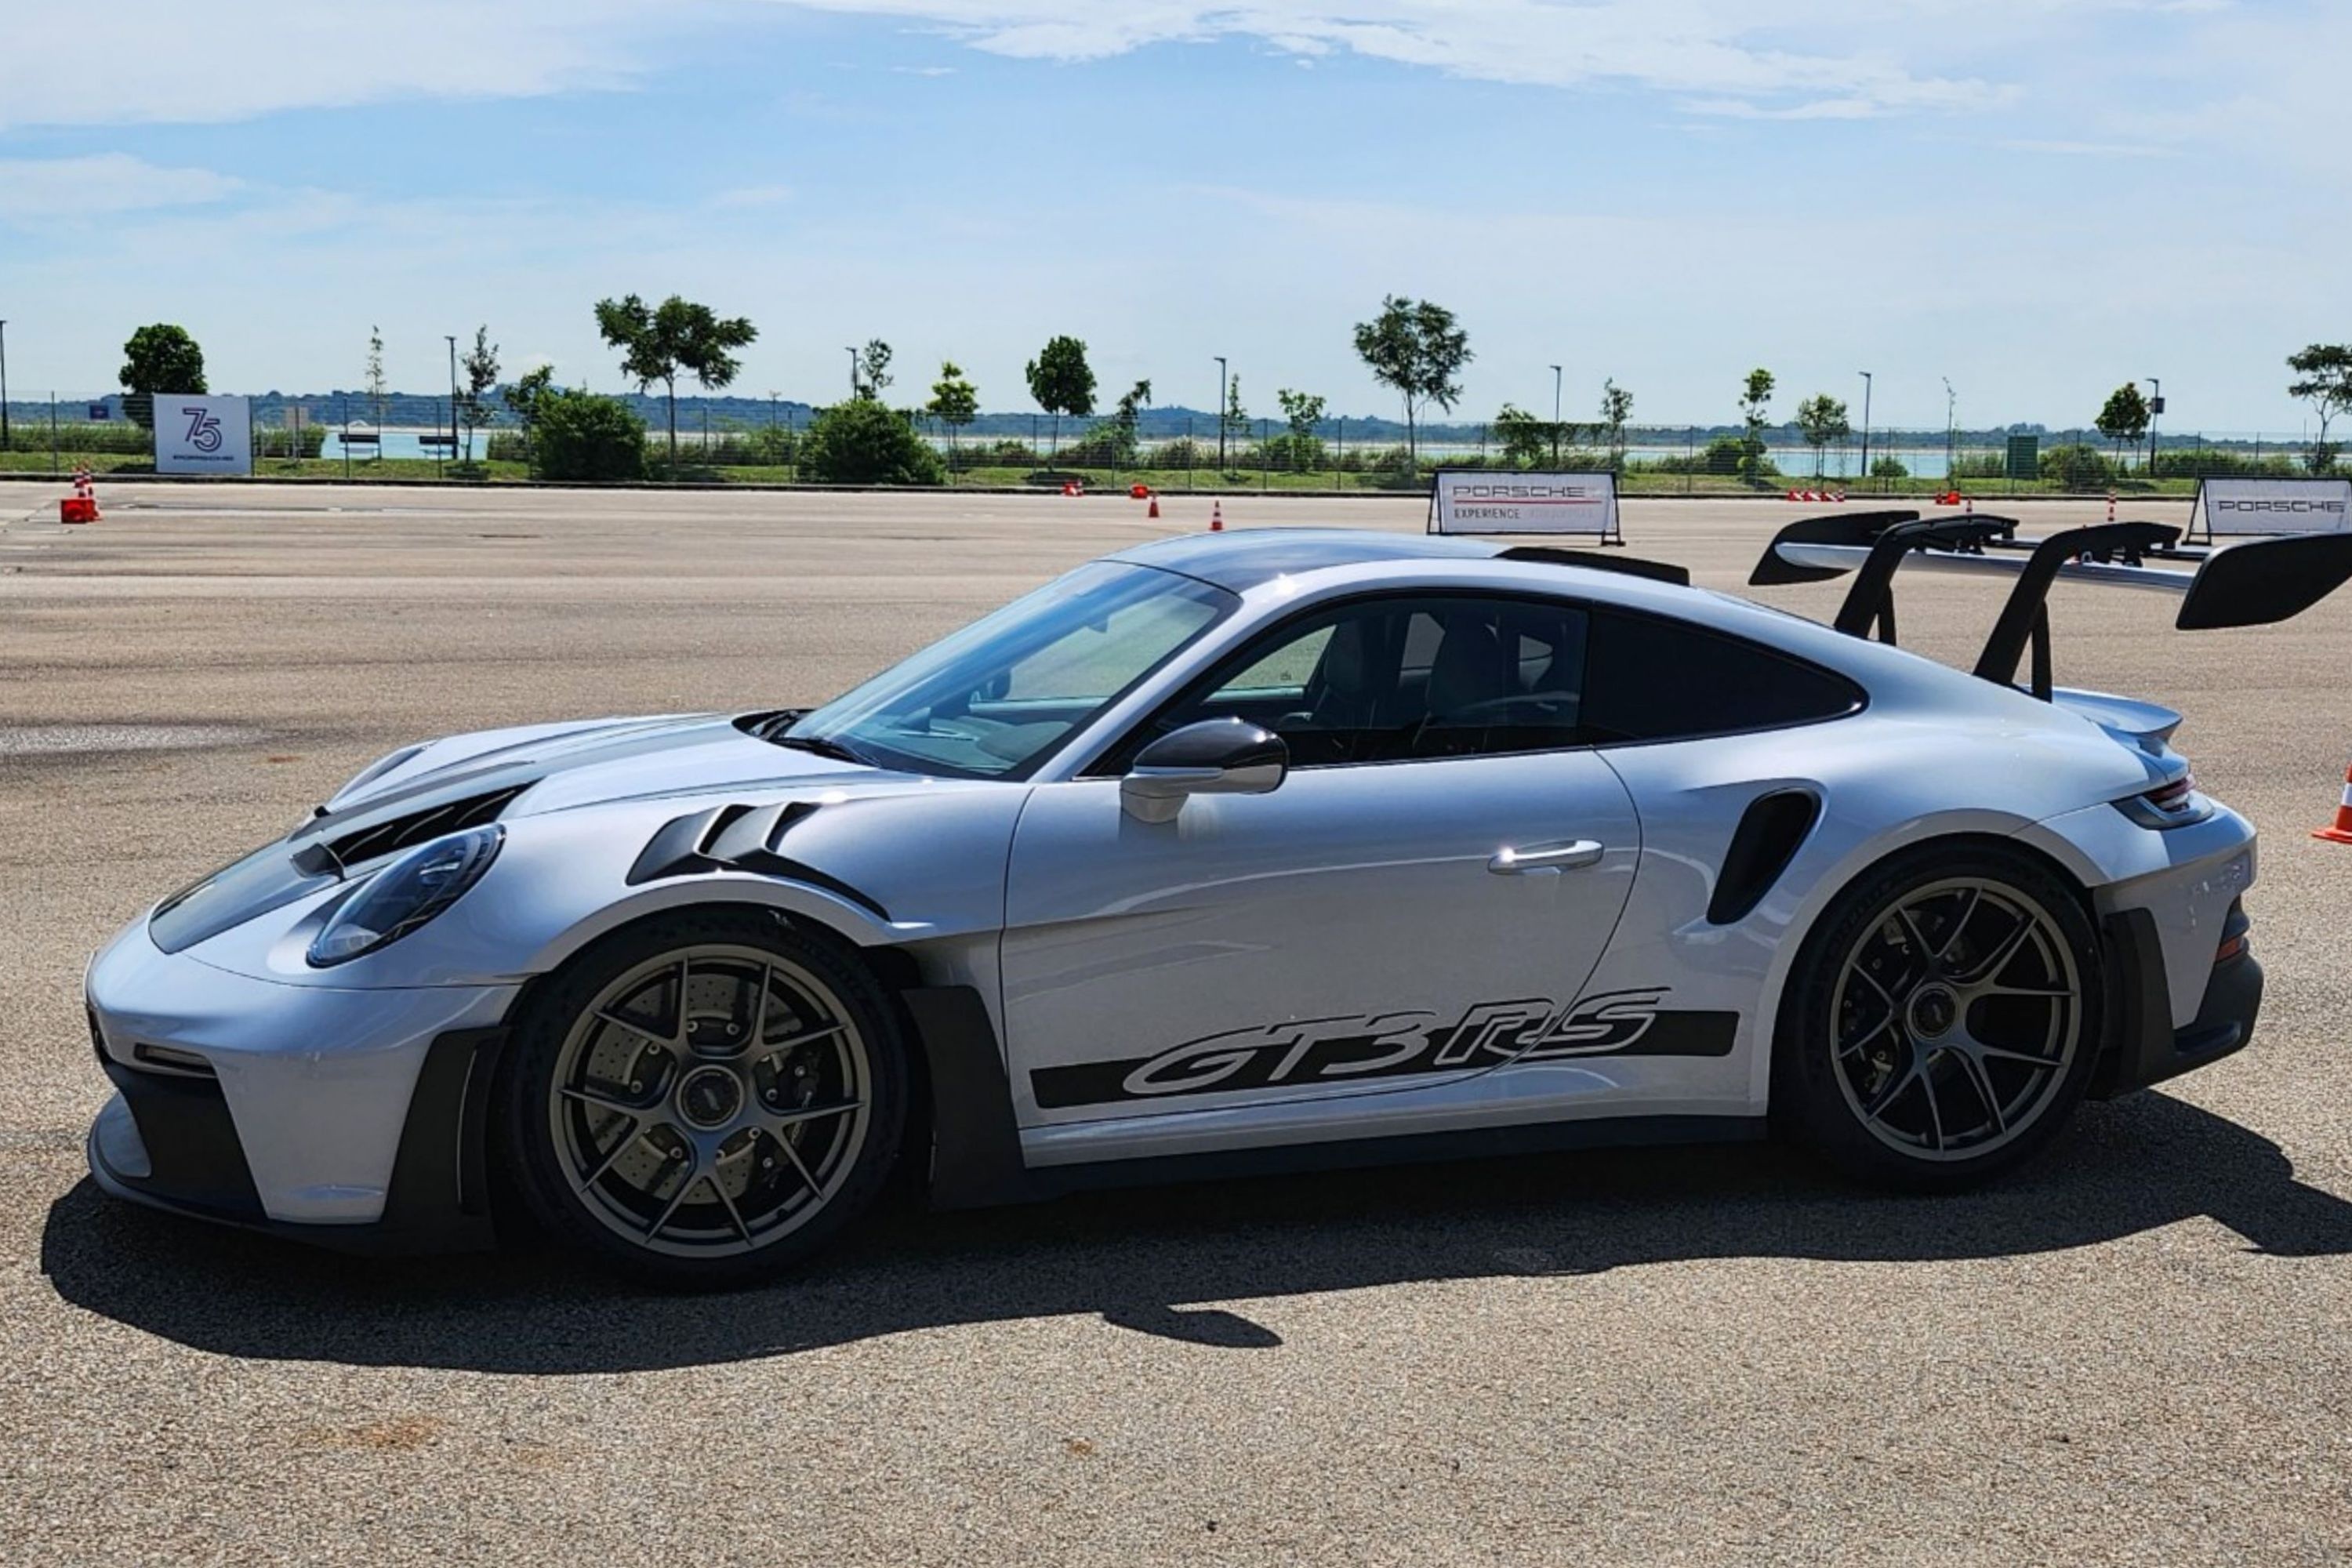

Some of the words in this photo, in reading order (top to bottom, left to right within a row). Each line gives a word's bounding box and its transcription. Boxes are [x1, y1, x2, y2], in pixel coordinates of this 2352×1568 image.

[182, 407, 222, 452] 75
[1453, 485, 1585, 497] PORSCHE
[2218, 500, 2345, 513] PORSCHE
[1454, 508, 1521, 519] EXPERIENCE
